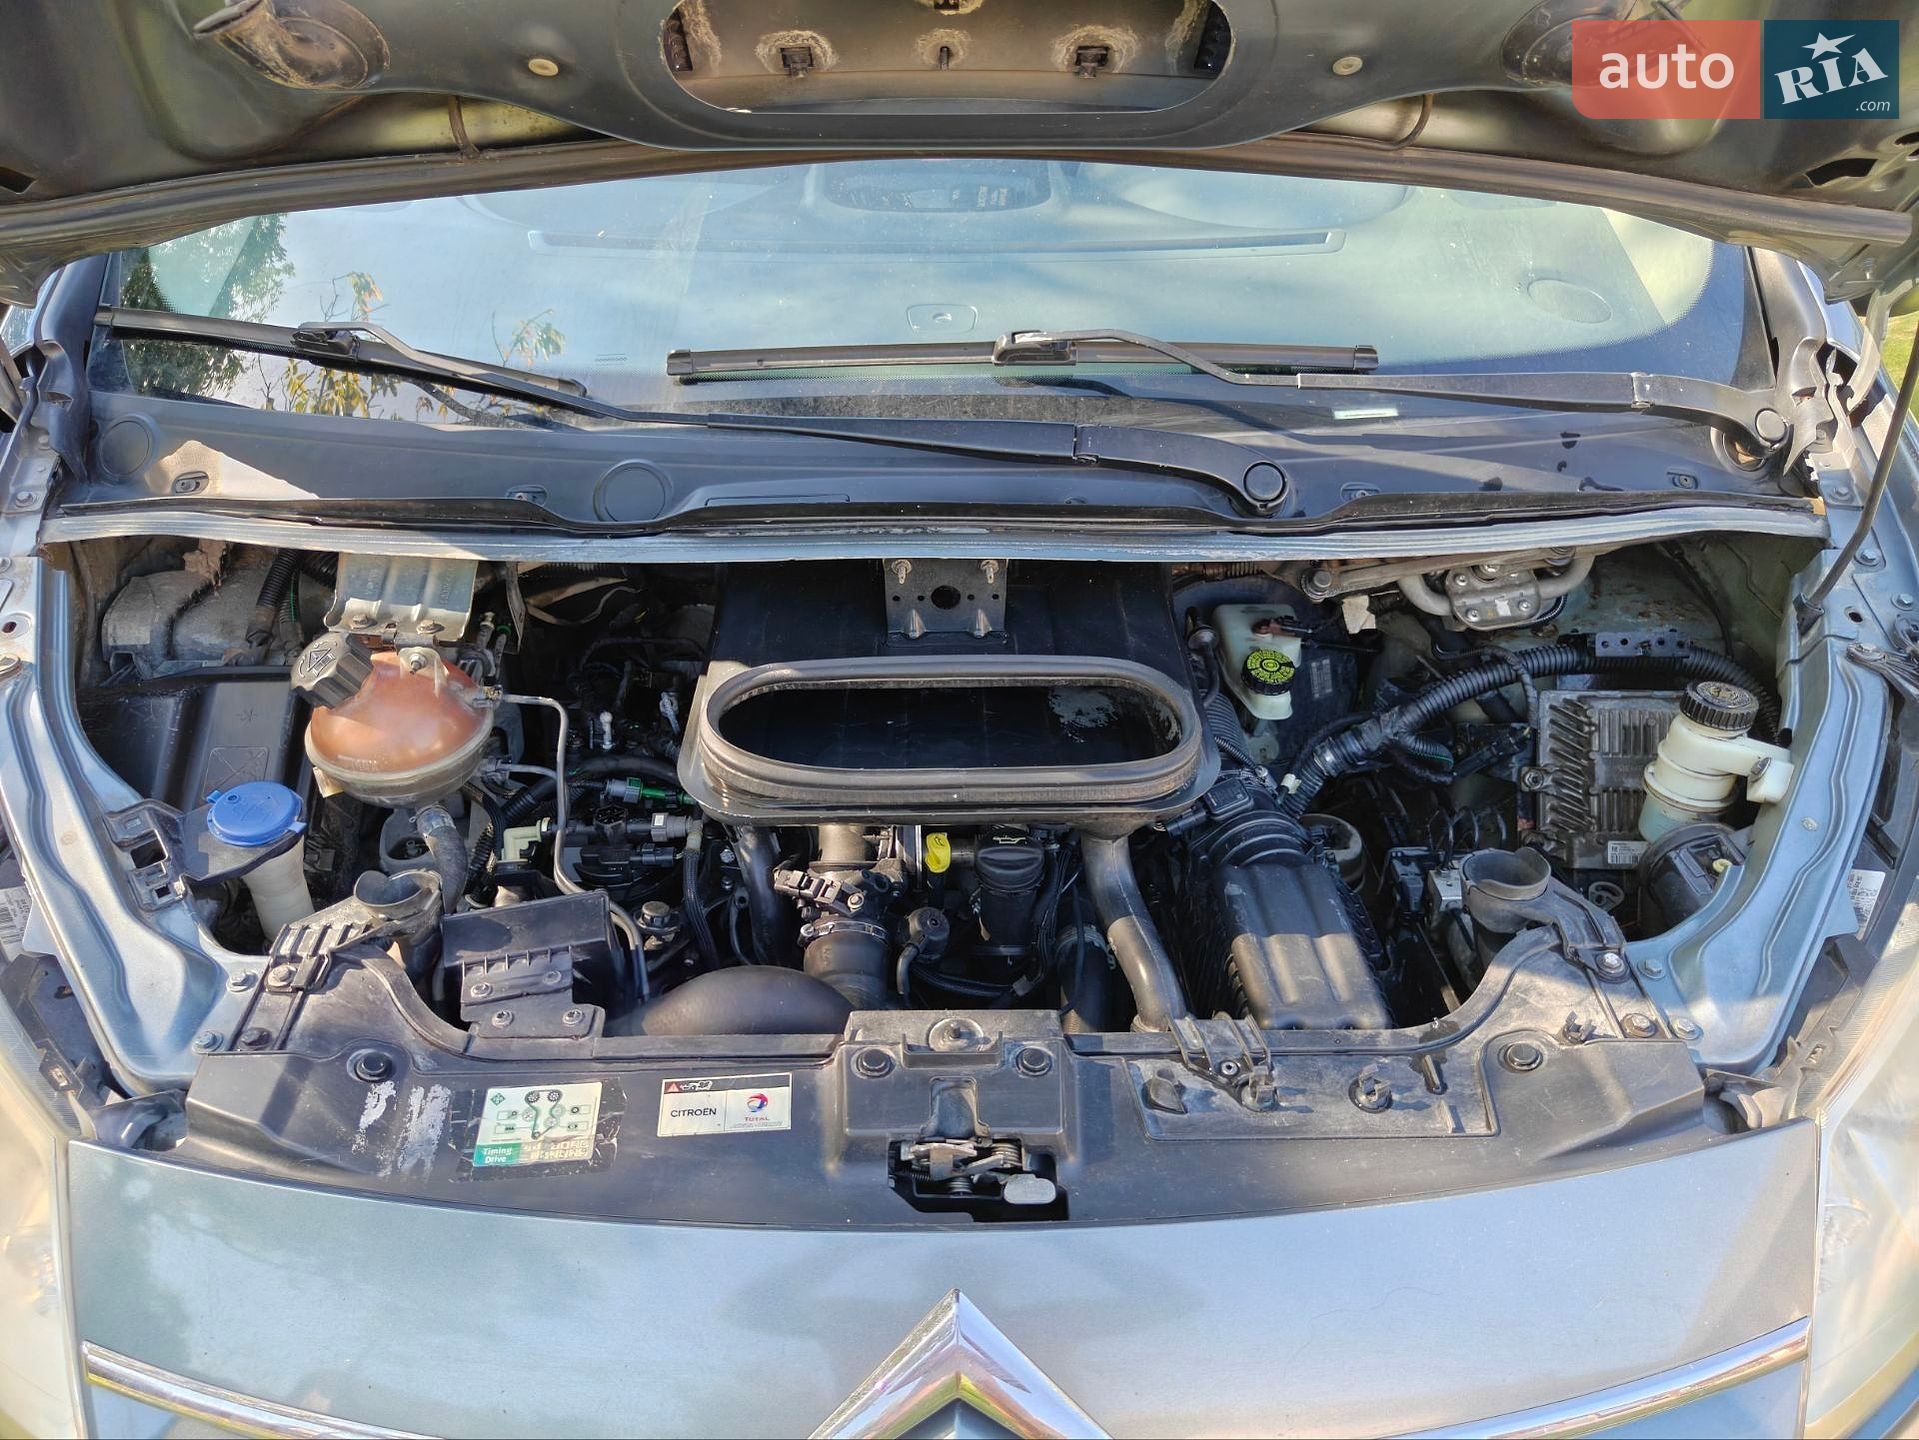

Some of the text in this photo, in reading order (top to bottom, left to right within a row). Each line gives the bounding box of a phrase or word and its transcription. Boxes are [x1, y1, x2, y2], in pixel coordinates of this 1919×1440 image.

[670, 1107, 717, 1118] CITROËN
[482, 1147, 513, 1156] Timing
[484, 1156, 507, 1164] Drive
